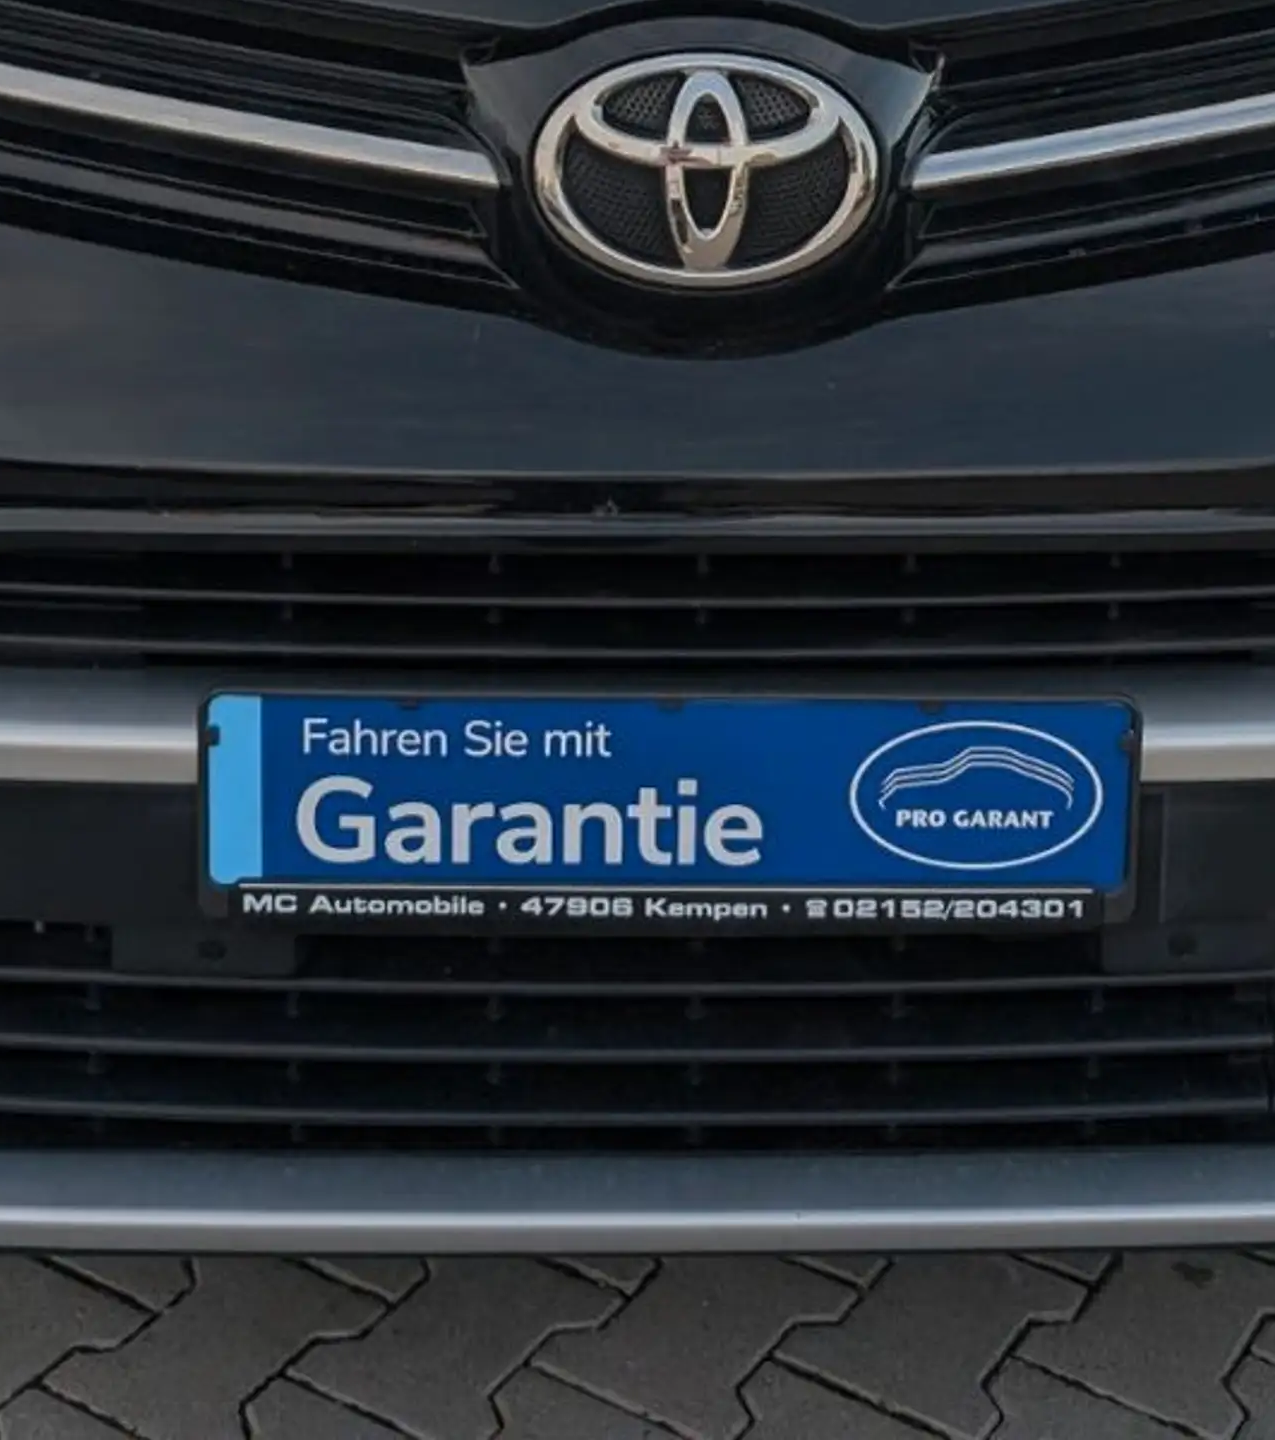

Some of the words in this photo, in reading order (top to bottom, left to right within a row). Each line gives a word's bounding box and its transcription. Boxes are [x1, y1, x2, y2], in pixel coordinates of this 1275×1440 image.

[302, 717, 448, 757] Fahren
[464, 719, 528, 758] Sie
[543, 721, 612, 758] mit
[295, 774, 764, 867] Garantie
[895, 809, 947, 828] PRO
[953, 809, 1055, 829] GARANT
[242, 892, 298, 914] MC
[309, 893, 486, 916] Automobile
[645, 897, 768, 921] Kempen
